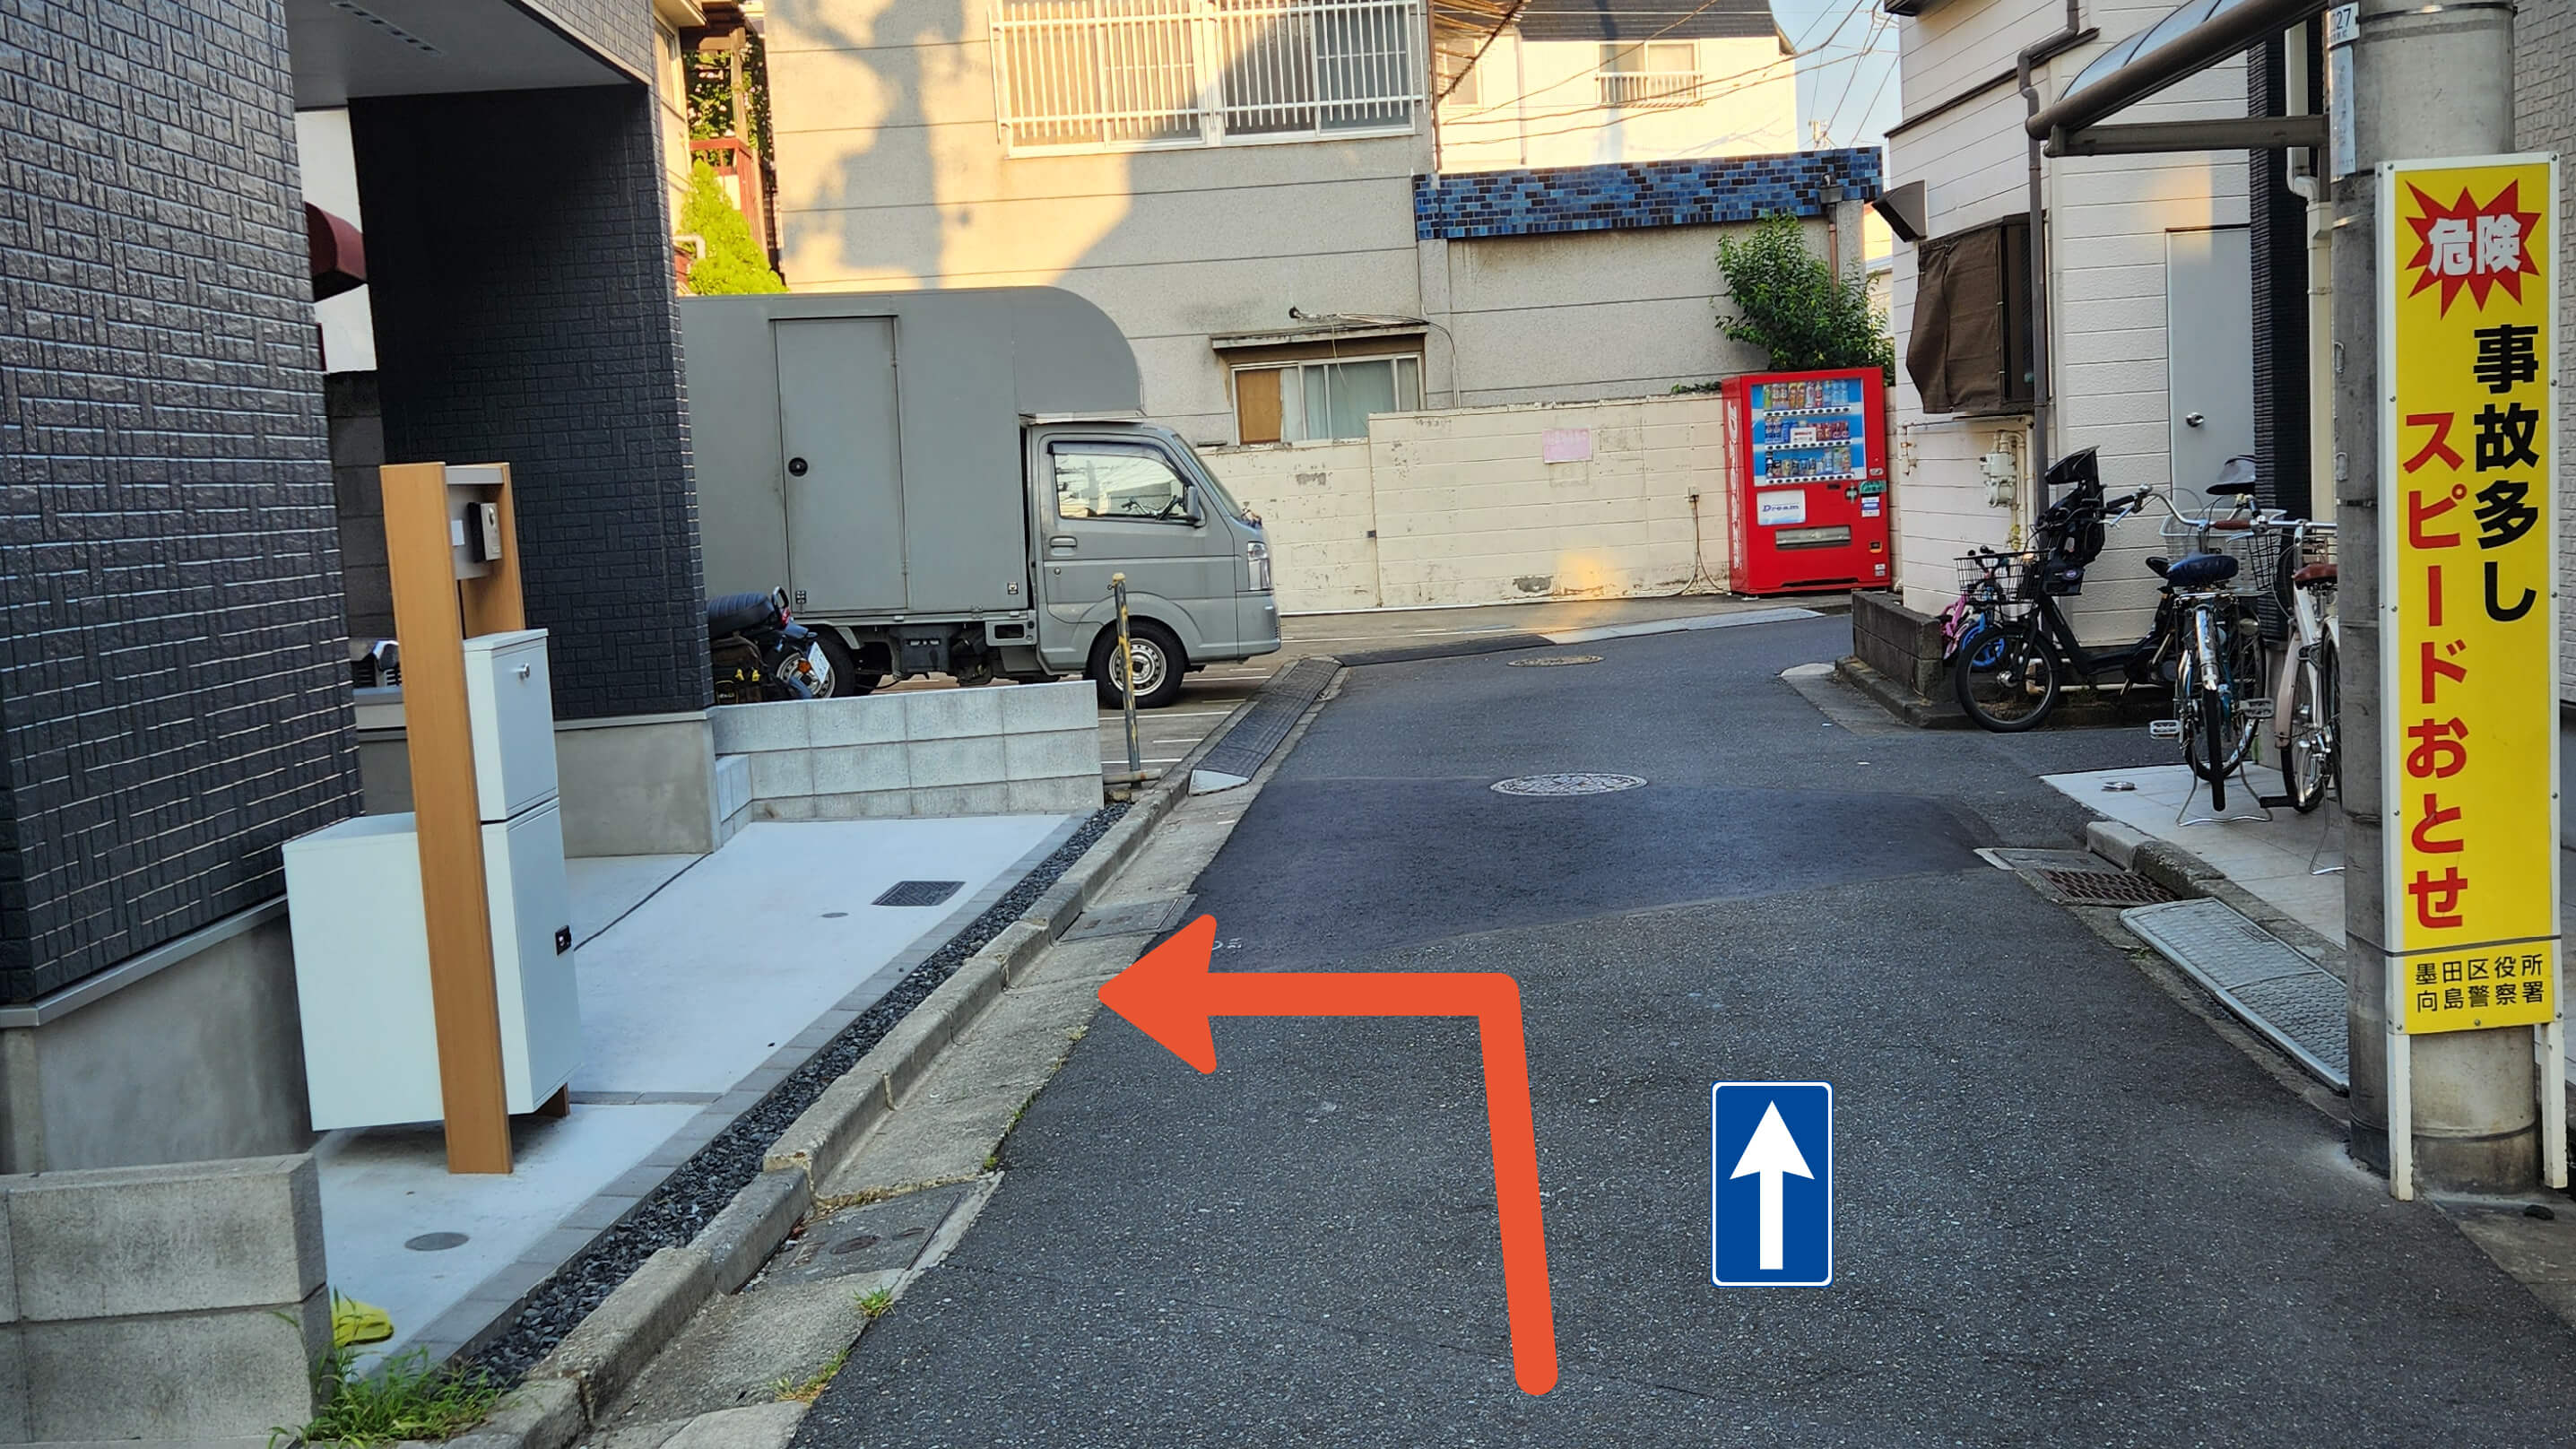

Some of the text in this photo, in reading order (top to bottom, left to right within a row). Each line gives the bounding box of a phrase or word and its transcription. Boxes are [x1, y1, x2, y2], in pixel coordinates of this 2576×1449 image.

[2427, 213, 2522, 277] 危険
[2473, 324, 2540, 622] 事故多し
[1763, 504, 1800, 512] Dream
[2403, 412, 2468, 929] スピードおとせ
[2416, 954, 2543, 985] 墨田区役所
[2416, 981, 2545, 1013] 向島警察署
